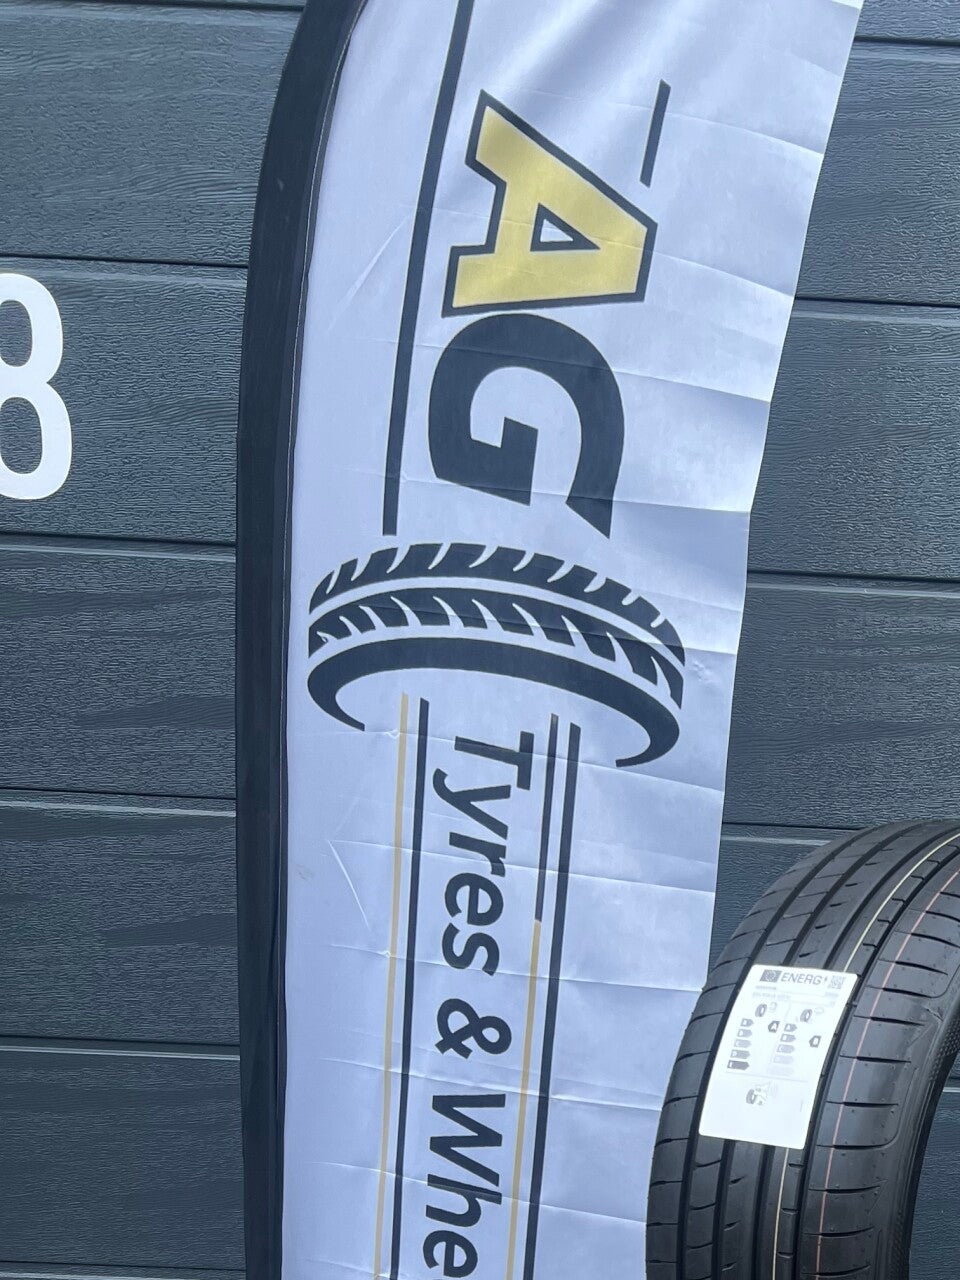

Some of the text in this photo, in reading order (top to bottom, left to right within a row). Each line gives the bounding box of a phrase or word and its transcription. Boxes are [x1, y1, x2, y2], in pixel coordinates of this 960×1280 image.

[0, 273, 73, 500] 8
[427, 90, 658, 540] AG
[432, 730, 534, 976] Tyres
[435, 1006, 513, 1062] &
[780, 972, 822, 985] ENERG
